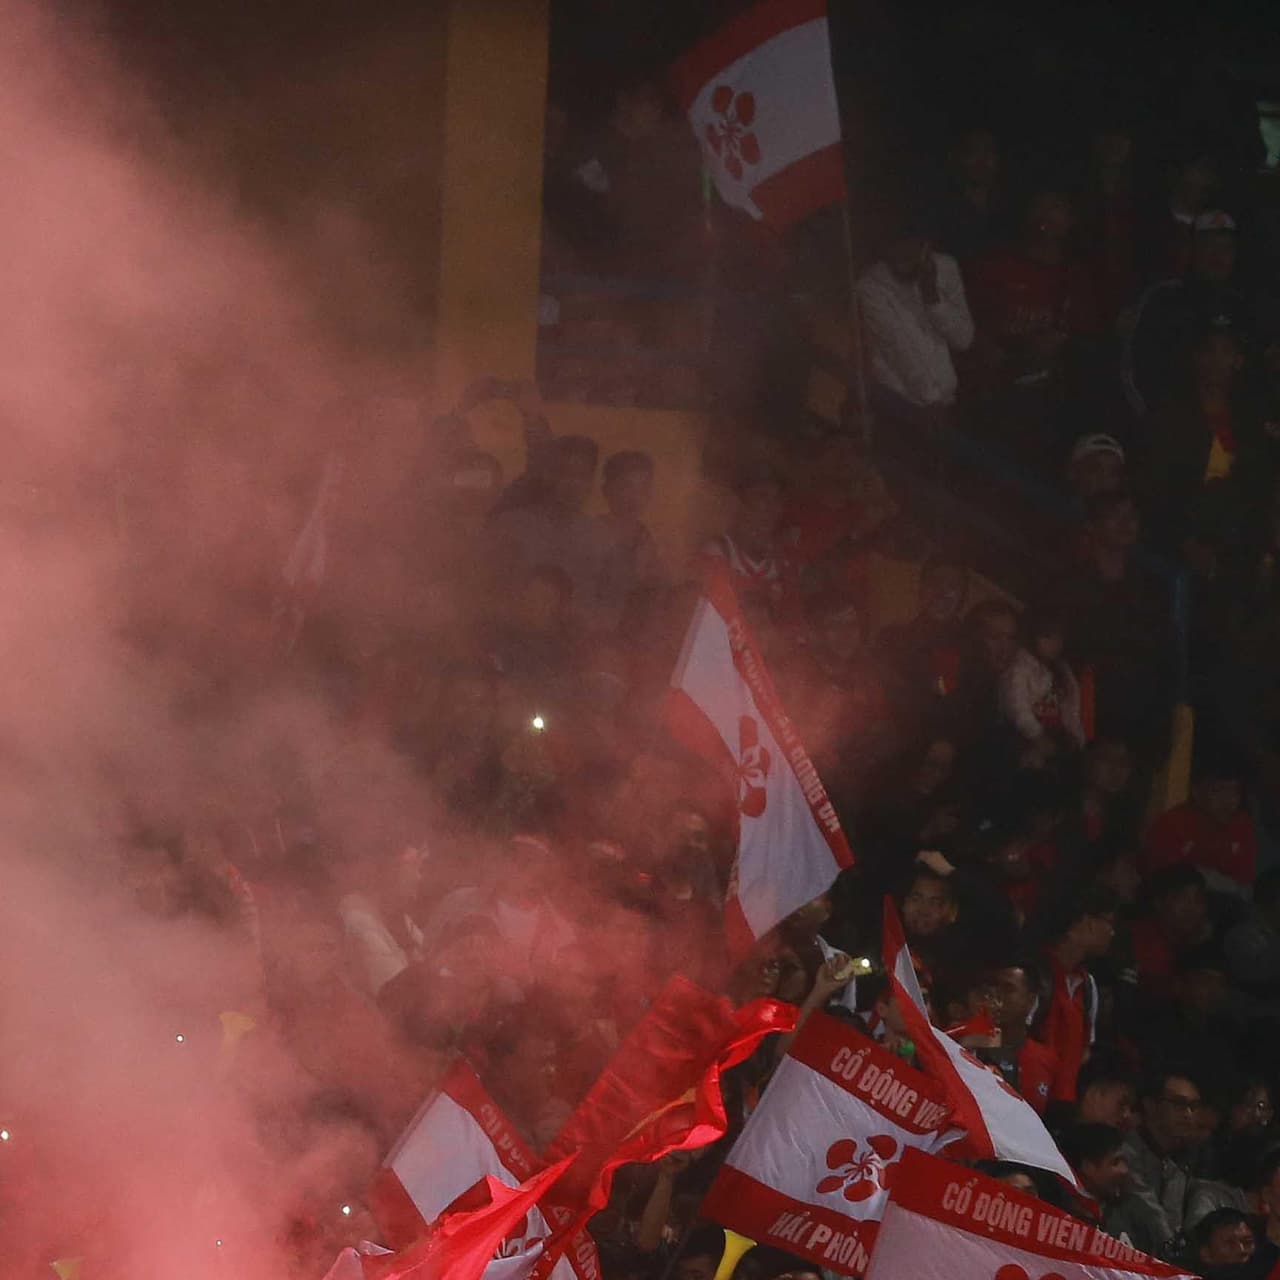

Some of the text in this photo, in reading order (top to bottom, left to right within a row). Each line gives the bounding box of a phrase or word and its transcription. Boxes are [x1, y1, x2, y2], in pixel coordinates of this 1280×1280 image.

[858, 1068, 918, 1118] ĐỘNG
[912, 1098, 948, 1130] VIÊ
[943, 1176, 980, 1217] CỔ
[972, 1189, 1032, 1236] ĐỘNG
[768, 1210, 869, 1273] HẢI PHÒN
